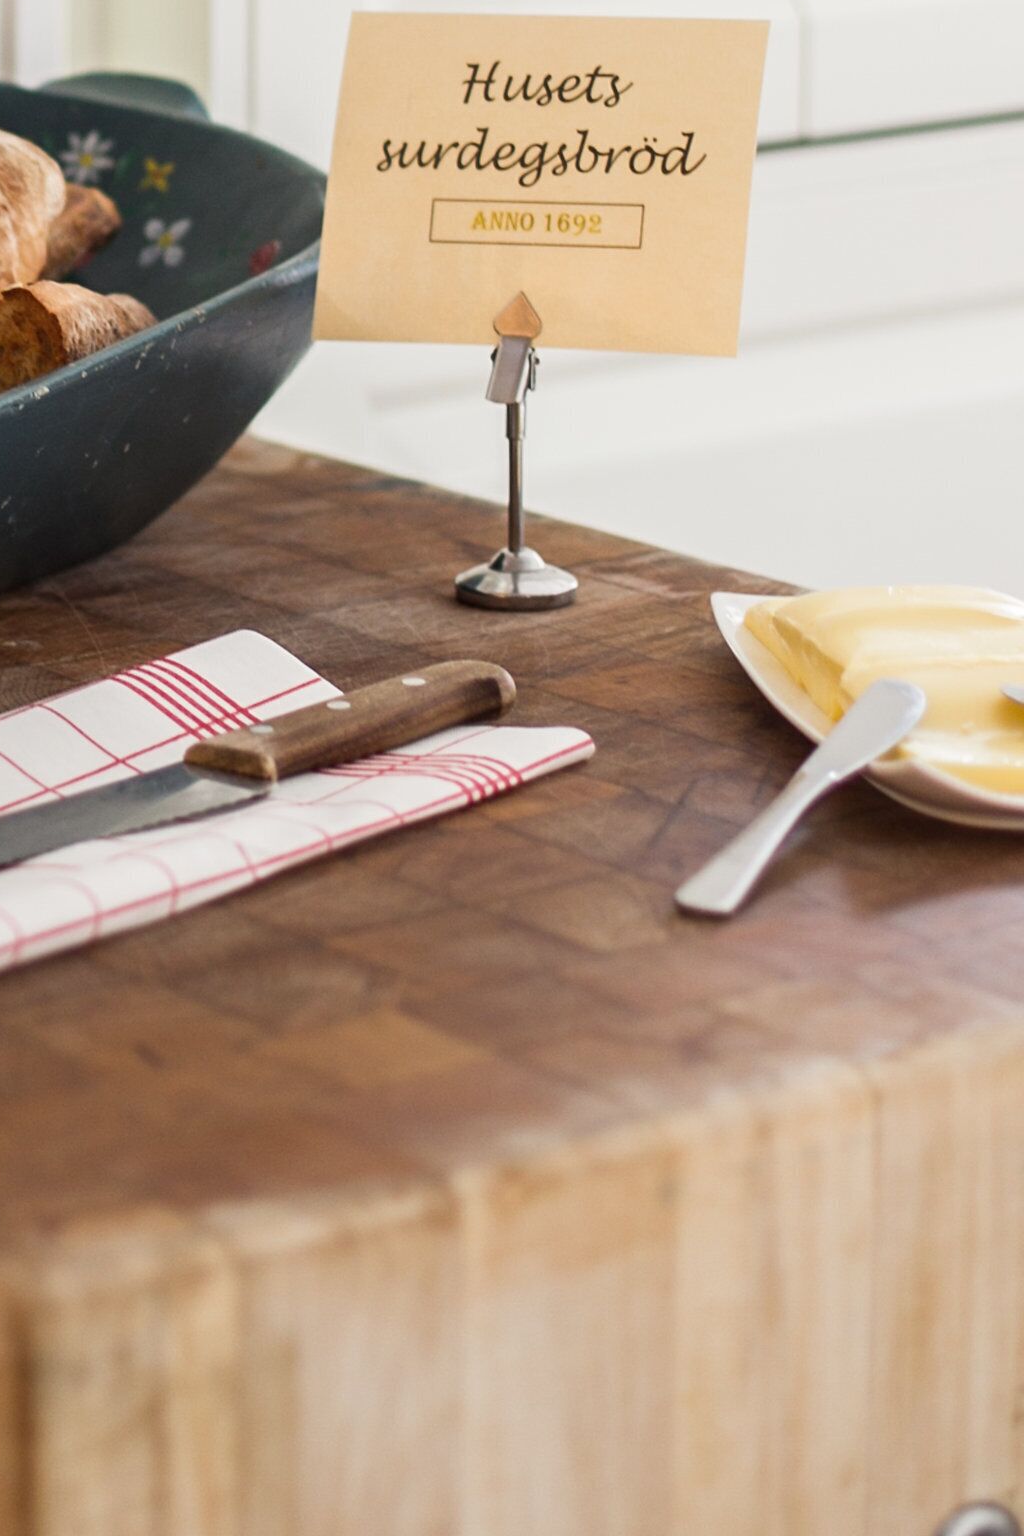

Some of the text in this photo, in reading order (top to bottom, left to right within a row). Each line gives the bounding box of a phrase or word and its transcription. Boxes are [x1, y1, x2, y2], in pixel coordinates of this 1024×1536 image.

[462, 60, 634, 108] Husets
[376, 127, 707, 187] surdegsbröd
[471, 210, 603, 235] ANNO 1692
